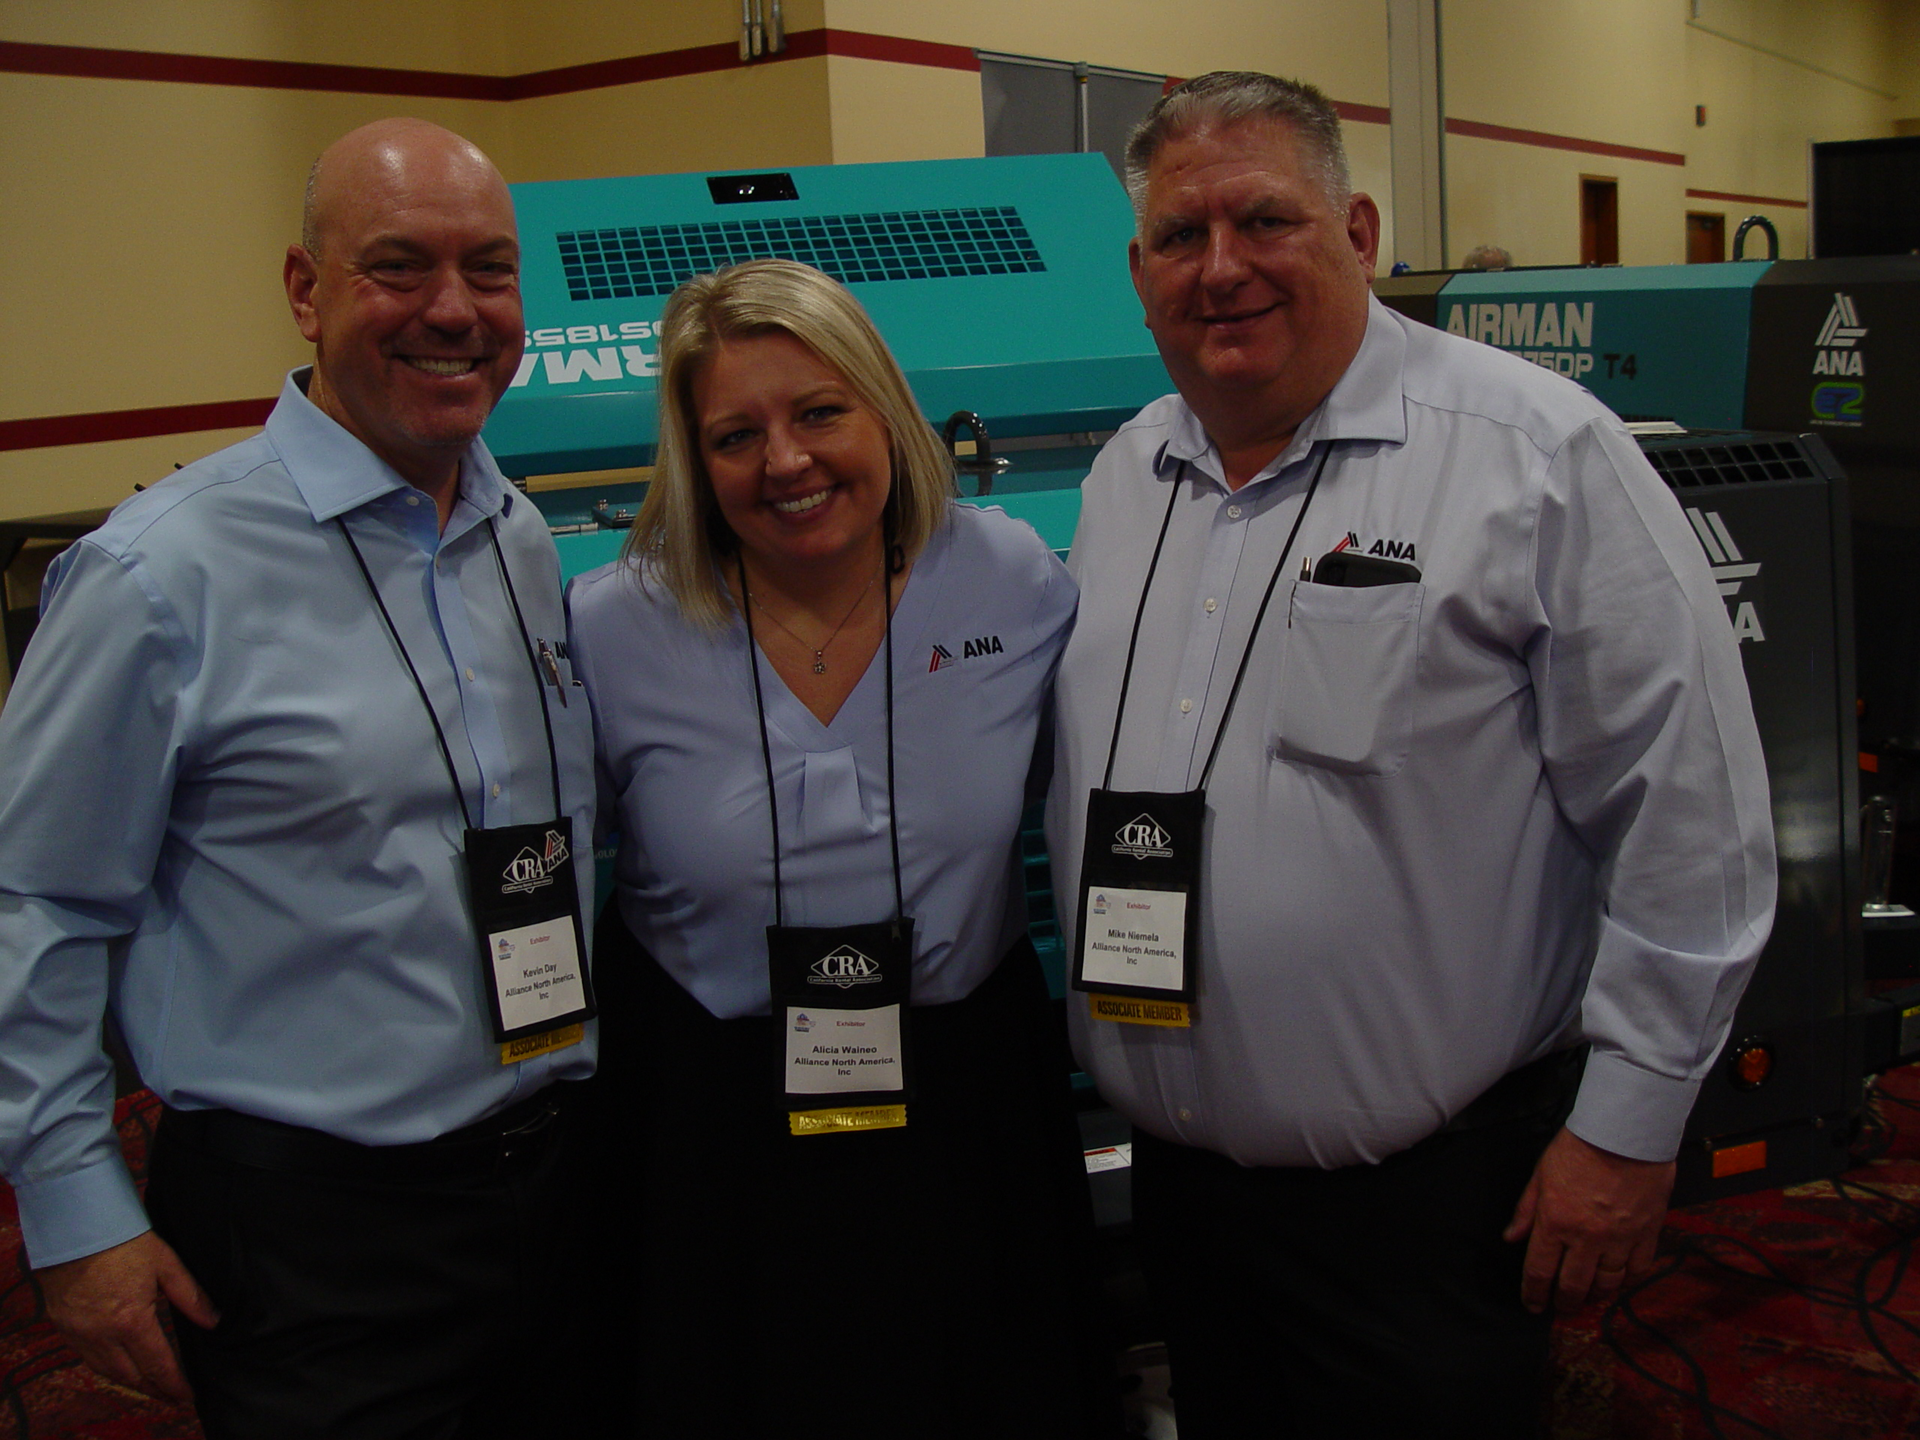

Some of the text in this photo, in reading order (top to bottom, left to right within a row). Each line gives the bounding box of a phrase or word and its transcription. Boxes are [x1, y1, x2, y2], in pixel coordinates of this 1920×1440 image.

[525, 321, 662, 348] S185
[1446, 302, 1594, 347] AIRMAN
[1603, 353, 1637, 380] T4
[1812, 350, 1864, 377] ANA
[1368, 539, 1416, 561] ANA
[964, 636, 1004, 659] ANA
[1123, 824, 1162, 848] CRA
[511, 856, 547, 882] CRA
[548, 848, 568, 870] ANA
[1126, 902, 1152, 910] Exhibitor
[1108, 929, 1159, 942] Mike Niemela
[1091, 942, 1177, 959] Alliance North America,
[1126, 956, 1138, 965] Inc
[523, 963, 557, 978] Kevin Day
[822, 955, 869, 977] CRA
[505, 984, 532, 997] Alliance
[533, 979, 551, 990] North
[539, 991, 549, 1000] Inc
[1097, 1001, 1182, 1021] ASSOCIATE MEMBER
[812, 1045, 877, 1054] Alicia Waineo
[794, 1057, 829, 1066] Alliance
[831, 1058, 857, 1066] North
